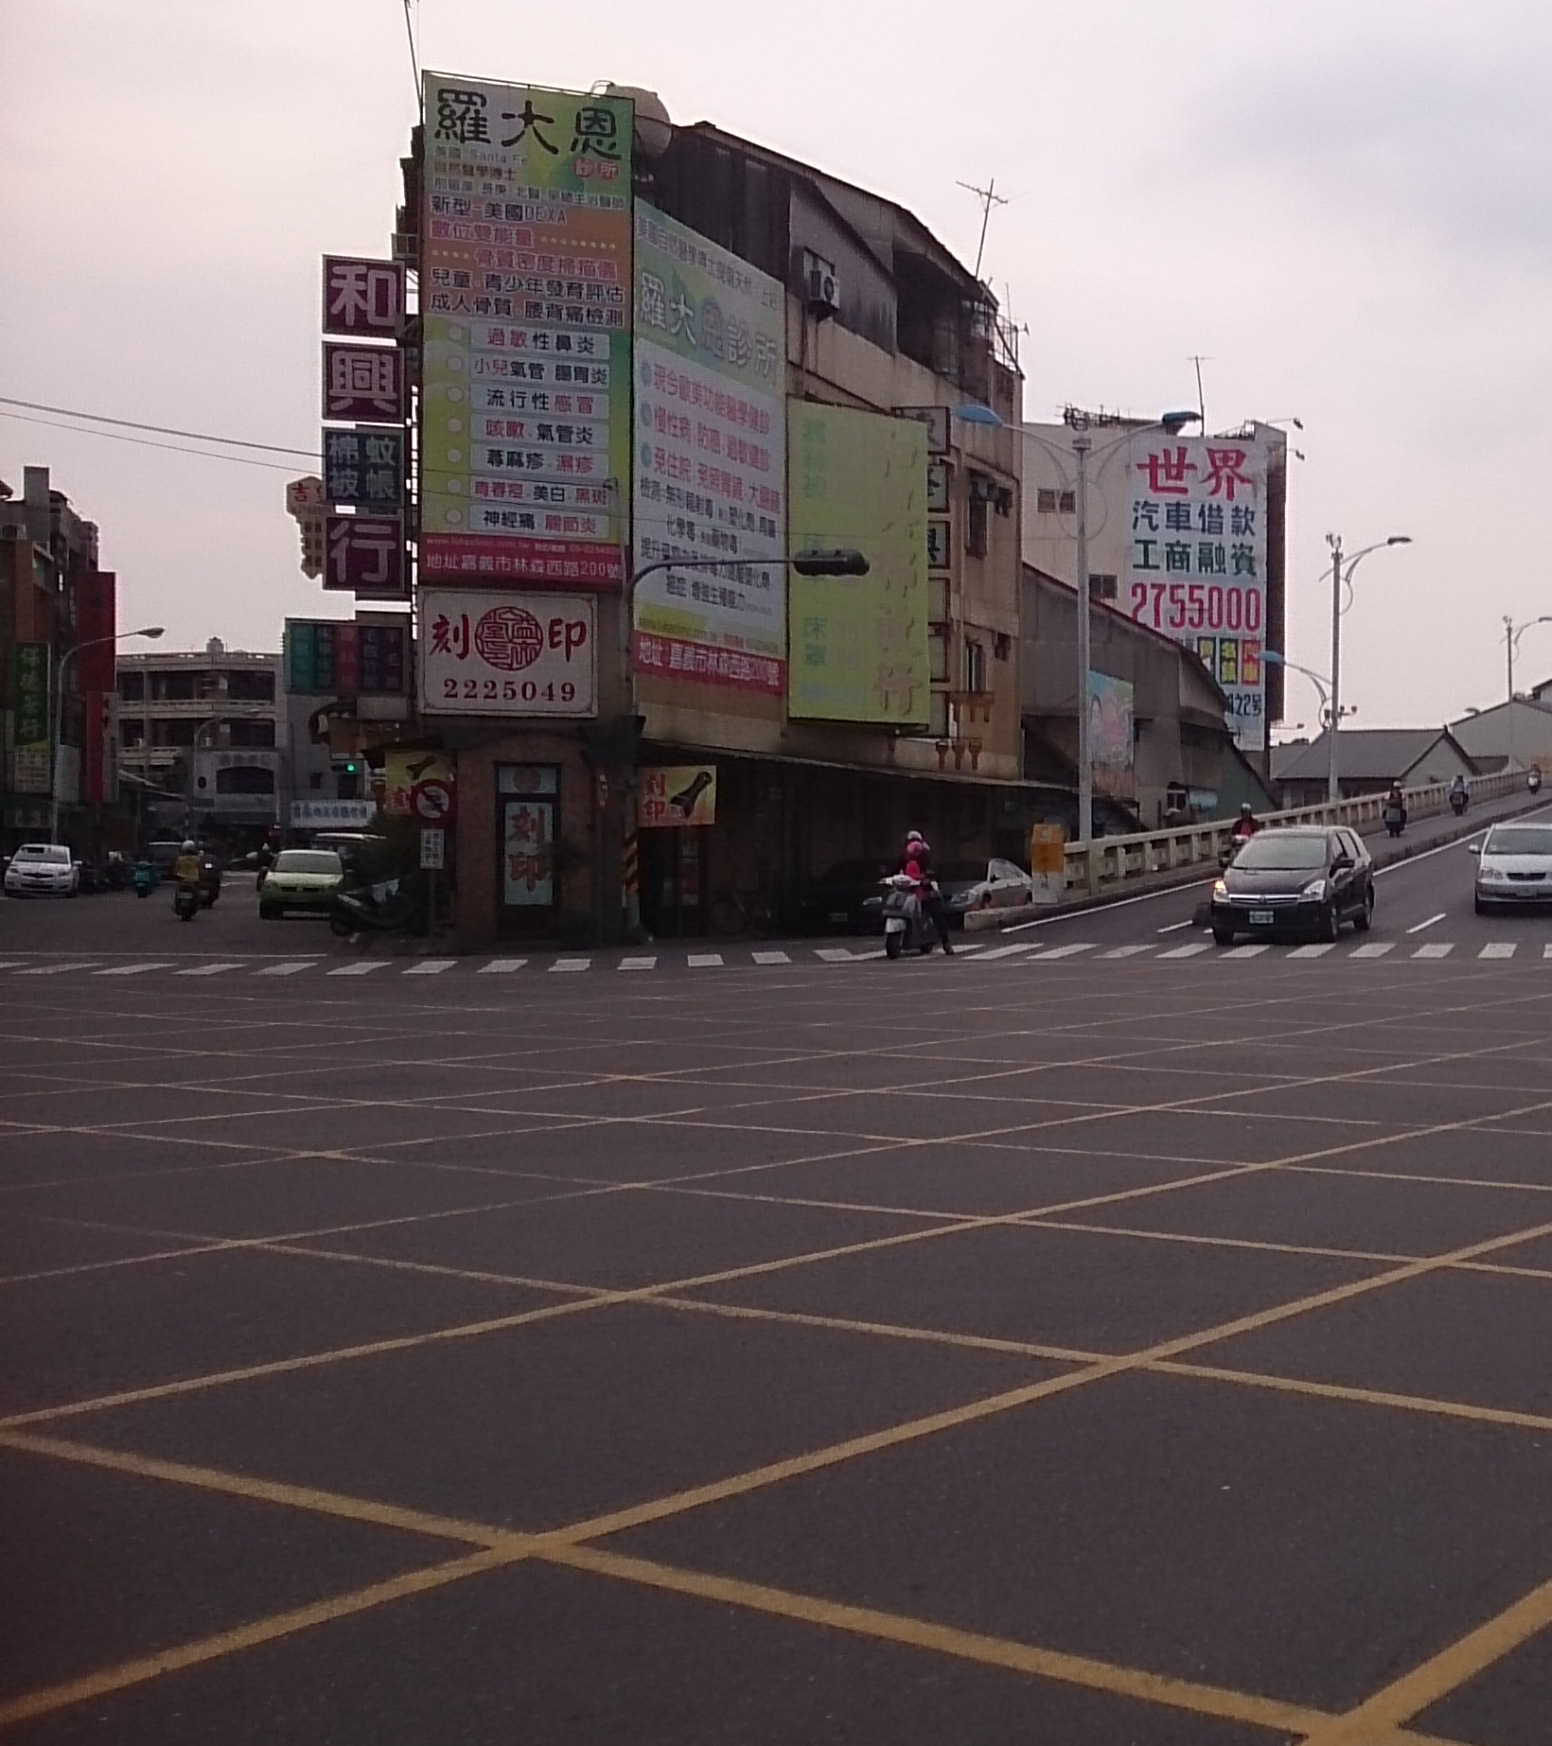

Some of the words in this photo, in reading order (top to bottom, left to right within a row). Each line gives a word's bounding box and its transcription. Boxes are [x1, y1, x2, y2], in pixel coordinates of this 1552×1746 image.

[435, 88, 622, 160] 羅大恩
[430, 219, 535, 248] 數位雙能量
[487, 327, 595, 355] 過敏性鼻炎
[641, 272, 777, 384] 羅大恩診所
[486, 388, 594, 415] 流行性感冒
[328, 435, 359, 498] 棉被
[1136, 446, 1254, 501] 世界
[1132, 501, 1256, 537] 汽車借款
[330, 519, 397, 584] 行
[1132, 539, 1258, 577] 工商融資
[1131, 583, 1261, 631] 2755000
[430, 613, 470, 660] 刻
[549, 618, 587, 662] 印
[444, 679, 576, 702] 2225049
[508, 806, 549, 893] 刻印
